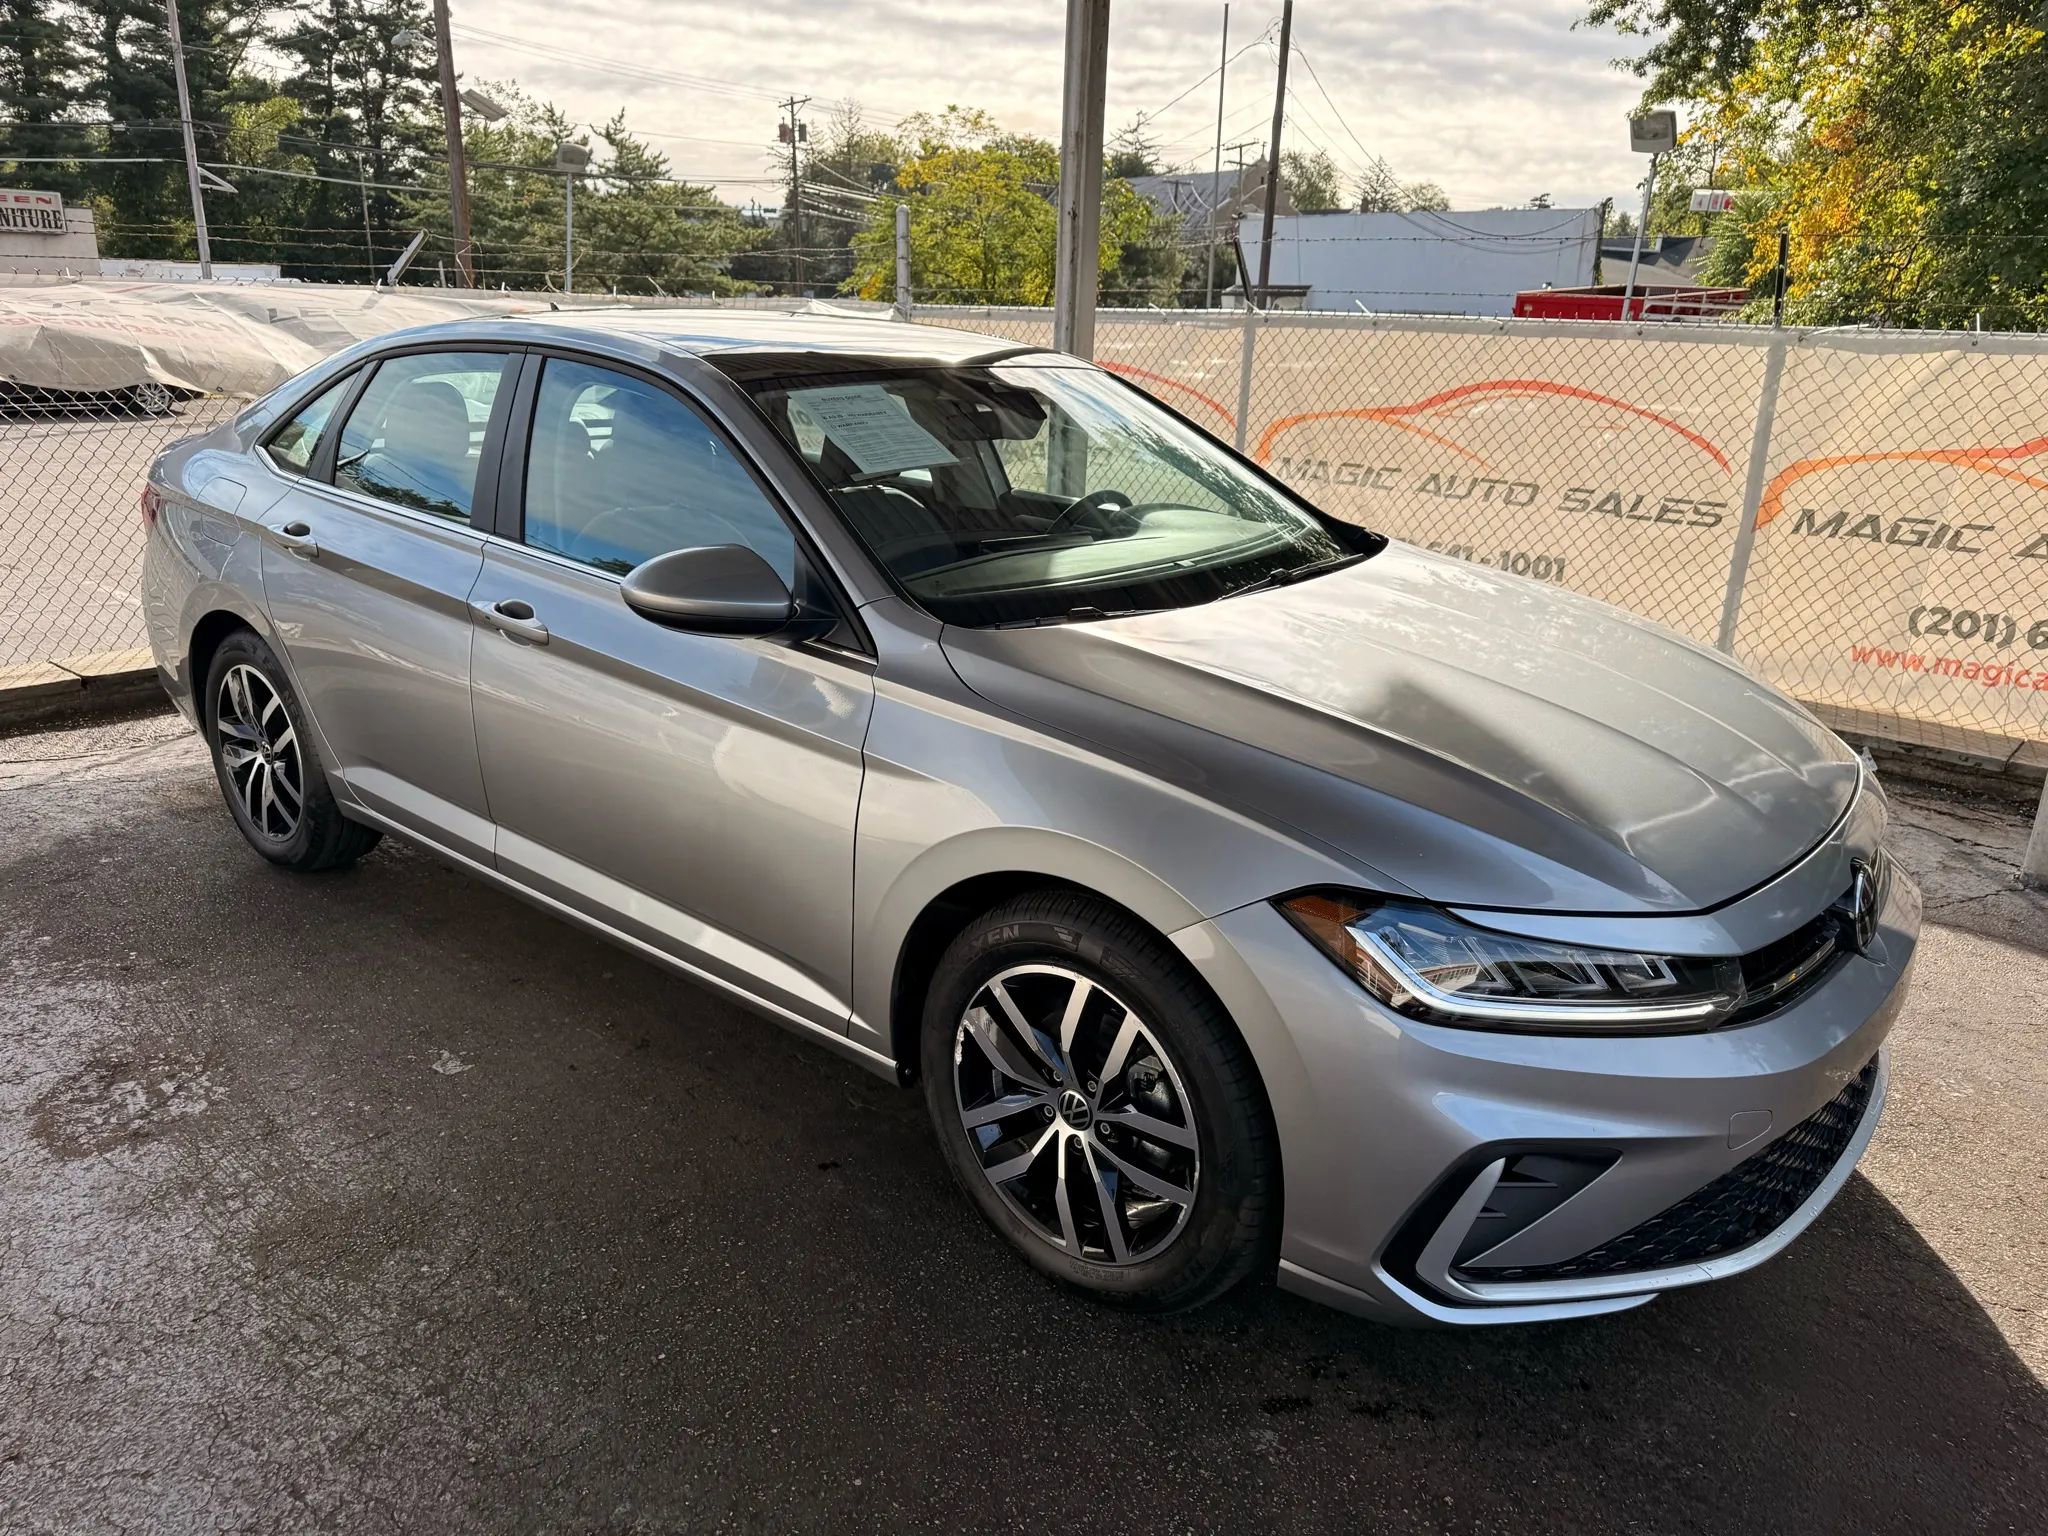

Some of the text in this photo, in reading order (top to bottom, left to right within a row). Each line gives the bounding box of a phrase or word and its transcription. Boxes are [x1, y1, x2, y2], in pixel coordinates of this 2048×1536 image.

[1277, 457, 1729, 527] MAGIC AUTO SALES
[1791, 508, 1996, 553] MAGIC
[1908, 605, 2017, 649] (201)
